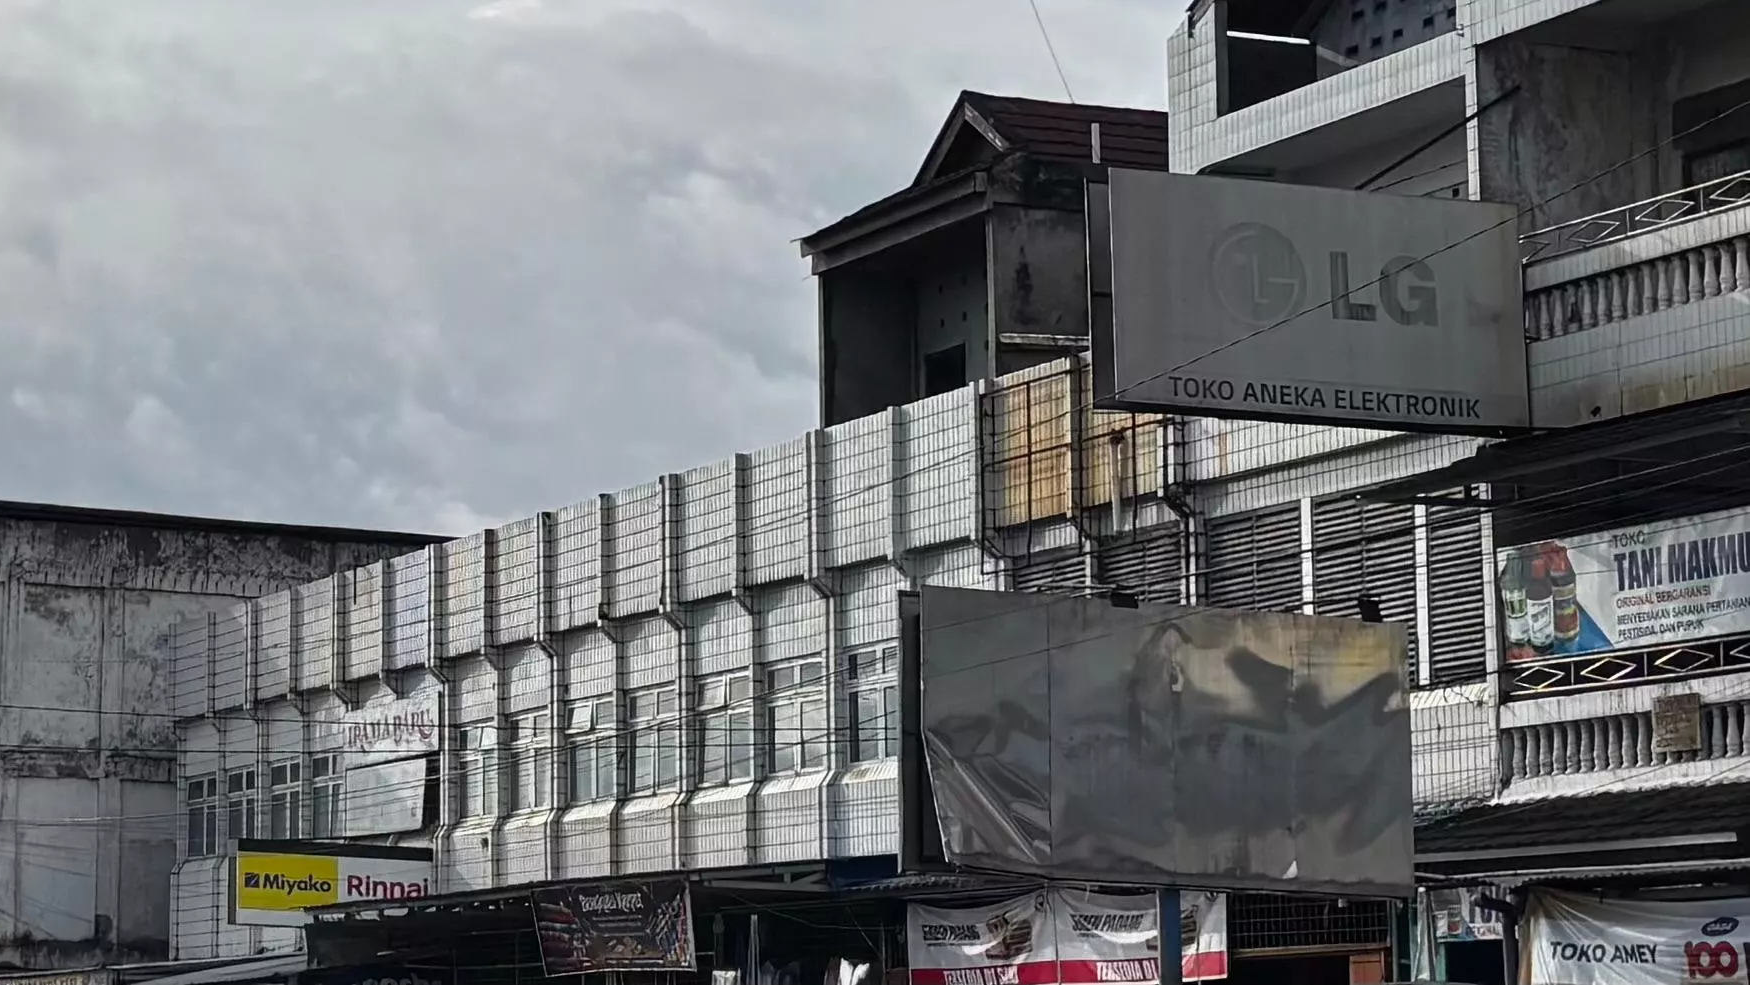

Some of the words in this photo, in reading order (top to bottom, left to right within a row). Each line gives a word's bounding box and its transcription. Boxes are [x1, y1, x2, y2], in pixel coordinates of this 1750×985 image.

[1329, 250, 1440, 327] LG
[1168, 376, 1235, 401] TOKO
[1242, 382, 1327, 409] ANEKA
[1334, 389, 1481, 418] ELEKTRONIK
[1611, 530, 1646, 548] TOKO
[1613, 546, 1663, 591] TANI
[1671, 603, 1706, 618] SARANA
[263, 874, 332, 897] Miyako
[346, 874, 429, 901] Rinnai
[1550, 940, 1606, 964] TOKO
[1609, 942, 1659, 964] AMEY
